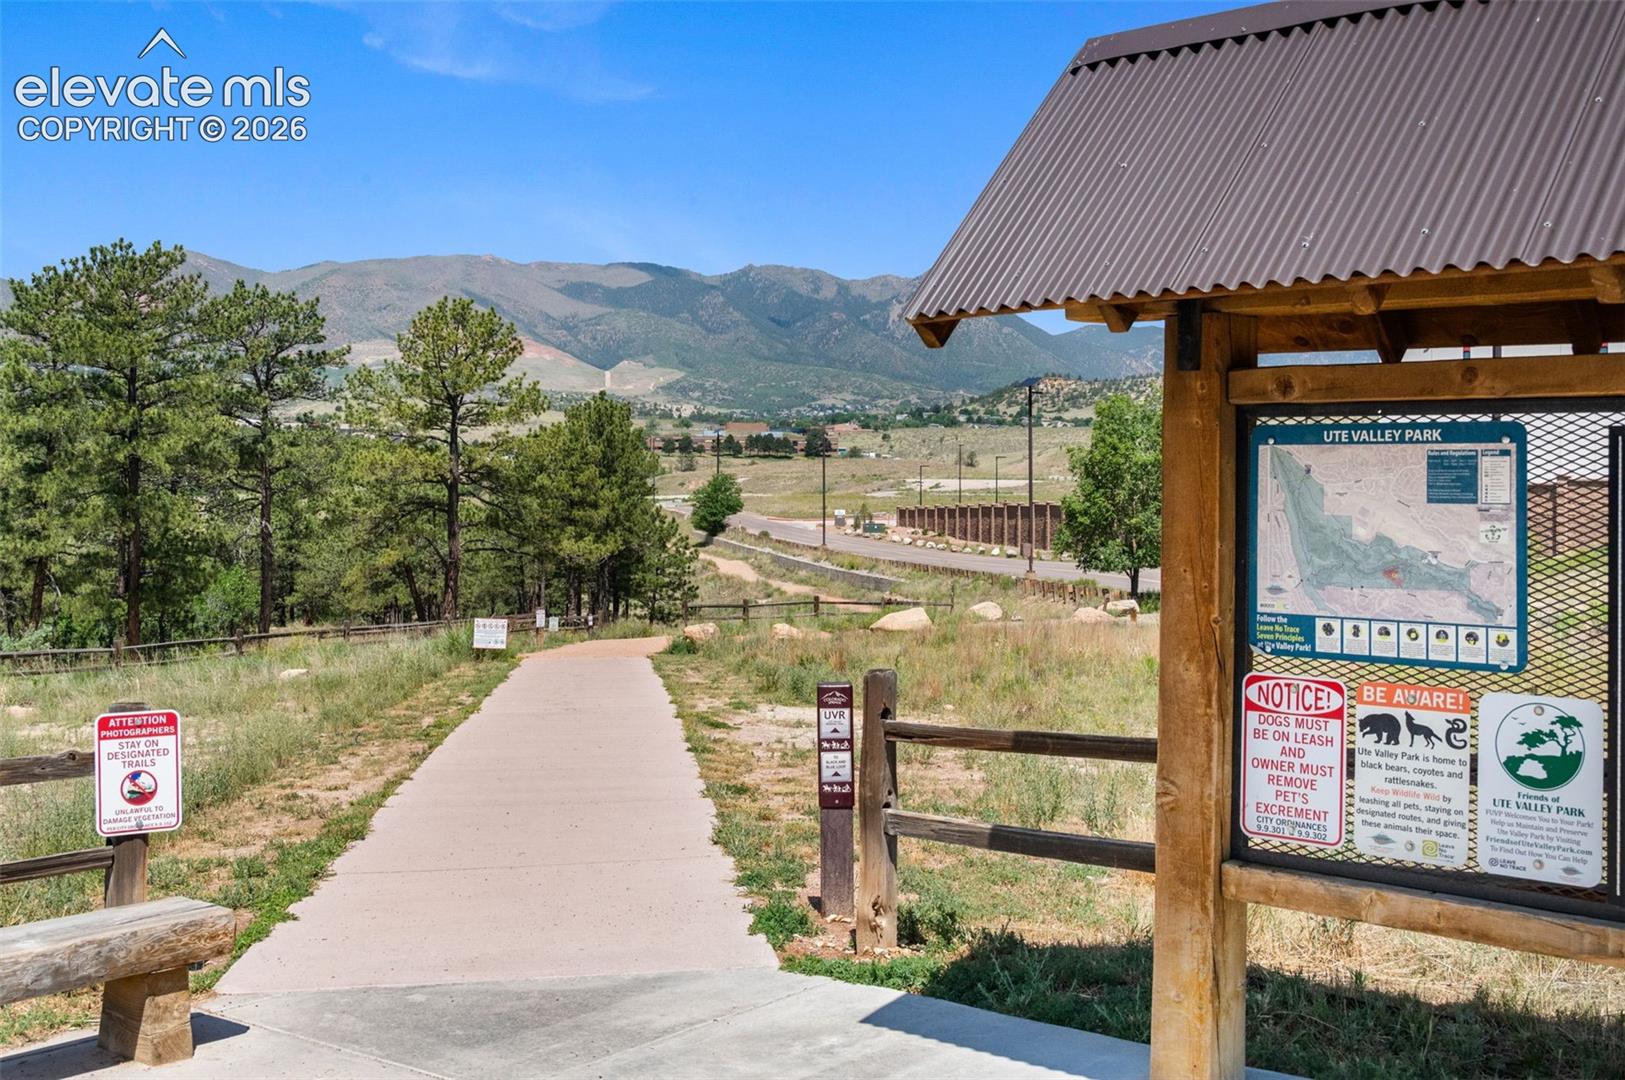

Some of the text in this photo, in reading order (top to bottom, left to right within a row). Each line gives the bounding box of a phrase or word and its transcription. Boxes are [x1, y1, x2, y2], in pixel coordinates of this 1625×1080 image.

[1324, 428, 1442, 443] UTE VALLEY PARK
[1256, 614, 1276, 622] Follow
[1256, 623, 1300, 633] Leave No Trace
[1256, 632, 1305, 643] Seven Principles
[1276, 642, 1294, 652] Valley
[1257, 682, 1331, 712] NOTICE!
[1363, 685, 1463, 710] BE AWARE!
[824, 711, 845, 720] UVR
[1258, 714, 1330, 732] DOGS MUST
[100, 726, 175, 738] PHOTOGRAPHERS
[1253, 728, 1334, 748] BE ON LEASH
[118, 739, 159, 750] STAY ON
[107, 748, 170, 761] DESIGNATED
[1280, 746, 1306, 759] AND
[1358, 747, 1372, 756] Ute
[1374, 749, 1398, 760] Valley
[1401, 752, 1420, 761] Park
[1422, 754, 1430, 762] is
[1432, 756, 1456, 766] home
[122, 759, 156, 769] TRAILS
[1251, 757, 1334, 778] OWNER MUST
[1361, 760, 1463, 779] black bears, coyotes and
[1268, 774, 1317, 790] REMOVE
[1384, 776, 1438, 789] rattlesnakes.
[1275, 790, 1308, 804] PET'S
[1370, 786, 1452, 805] Keep Wildlife Wild by
[1517, 792, 1549, 802] Friends
[115, 806, 153, 816] UNLAWFUL
[1256, 802, 1329, 822] EXCREMENT
[1359, 796, 1390, 808] leashing
[1403, 802, 1422, 811] pets,
[1424, 805, 1452, 816] staying
[1493, 798, 1586, 818] UTE VALLEY PARK
[103, 812, 176, 825] DAMAGE VEGETATION
[1256, 816, 1273, 825] CITY
[1276, 818, 1327, 832] ORDINANCES
[1356, 808, 1396, 818] designated
[1398, 814, 1424, 823] routes,
[1443, 819, 1467, 829] giving
[1504, 811, 1536, 821] Welcomes
[1560, 818, 1574, 826] Your
[1256, 824, 1285, 835] 9.9.301
[1297, 830, 1327, 841] 9.9.302
[1361, 819, 1460, 839] these animals their space.
[1490, 819, 1506, 827] Help
[1516, 821, 1544, 831] Maintain
[1560, 827, 1588, 837] Preserve
[1510, 830, 1528, 839] Valley
[1530, 832, 1545, 840] Park
[1546, 834, 1554, 842] by
[1555, 836, 1581, 846] Visiting
[1528, 850, 1543, 858] How
[1544, 852, 1557, 860] You
[1572, 856, 1588, 865] Help
